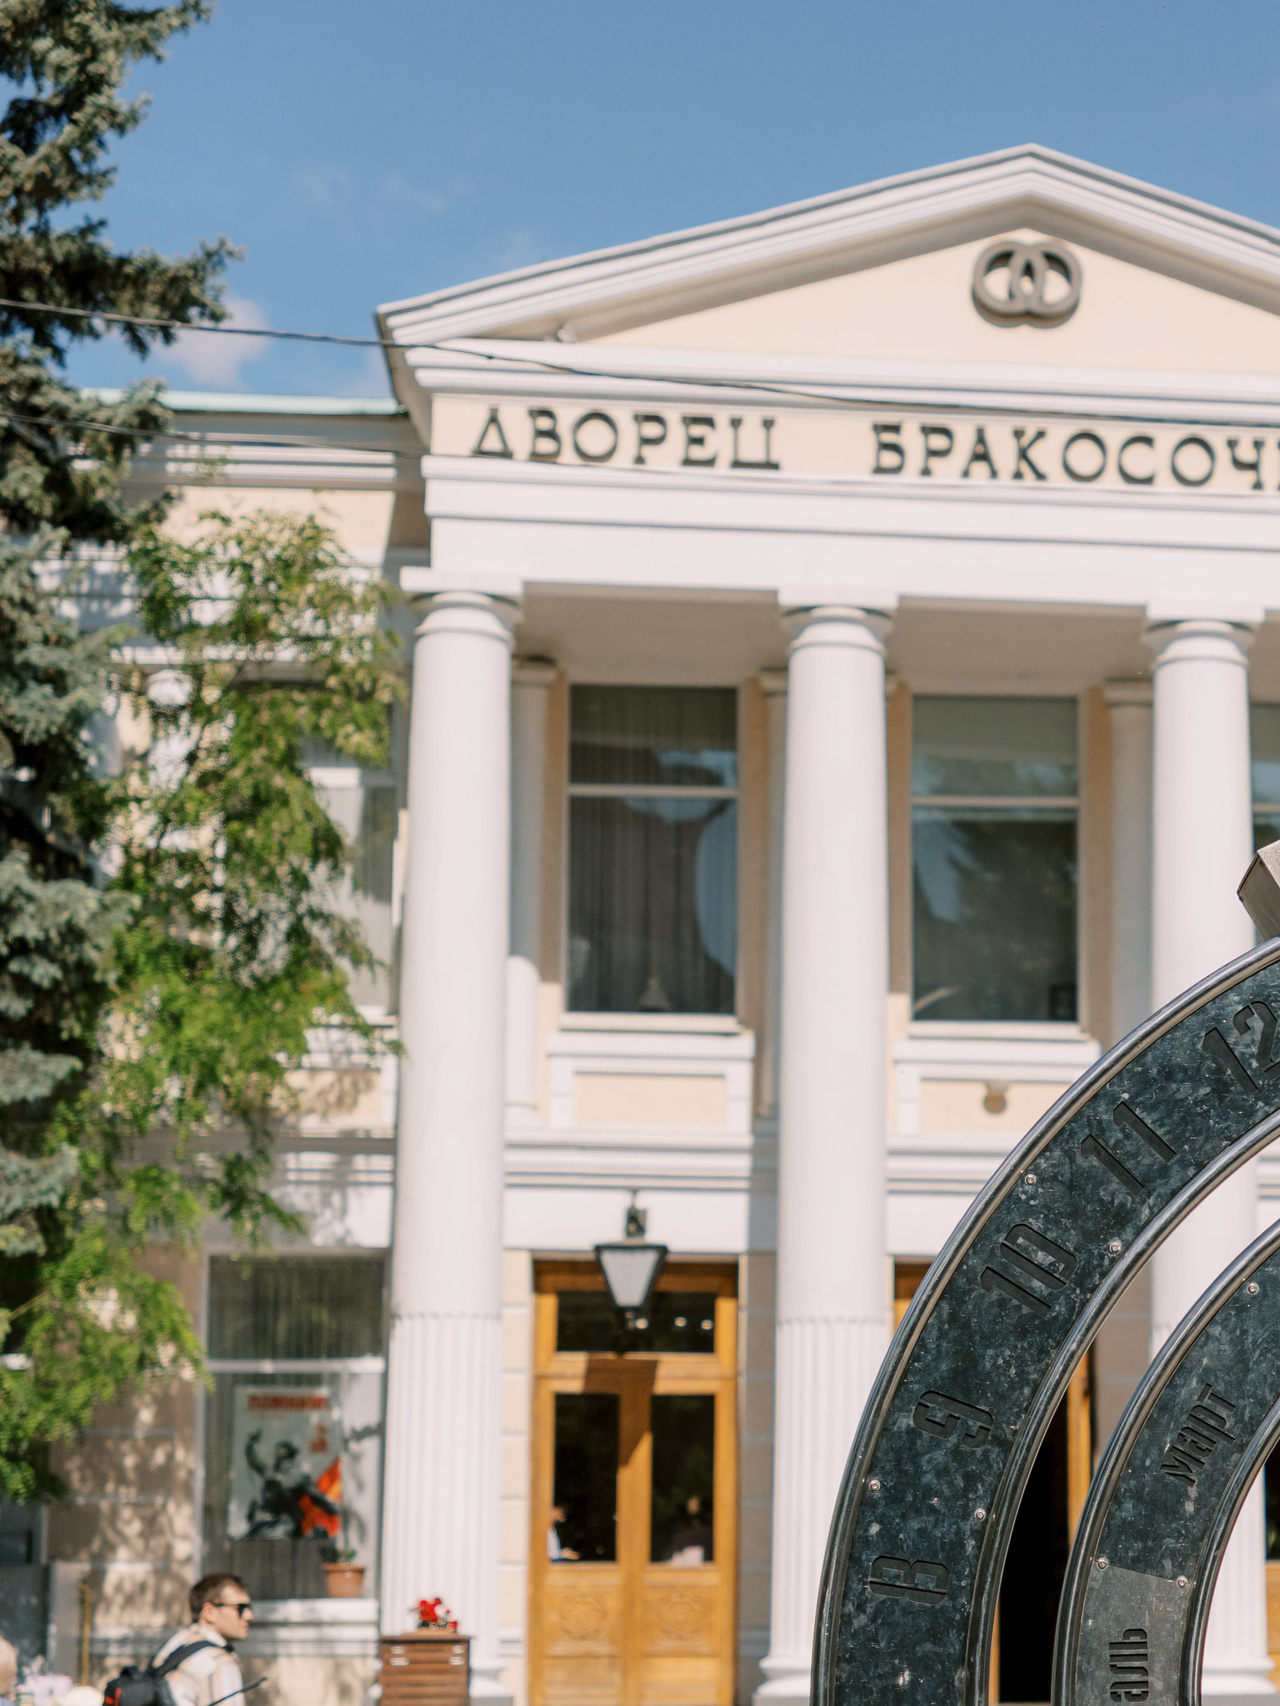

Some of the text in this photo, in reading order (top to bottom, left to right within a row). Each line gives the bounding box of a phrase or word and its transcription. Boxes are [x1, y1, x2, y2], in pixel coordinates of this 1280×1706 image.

[471, 407, 780, 471] ДВОРЕЦ
[1080, 1101, 1177, 1196] 11
[980, 1223, 1079, 1319] 10
[912, 1390, 995, 1450] 9
[1159, 1383, 1237, 1487] март
[869, 1555, 950, 1605] 8
